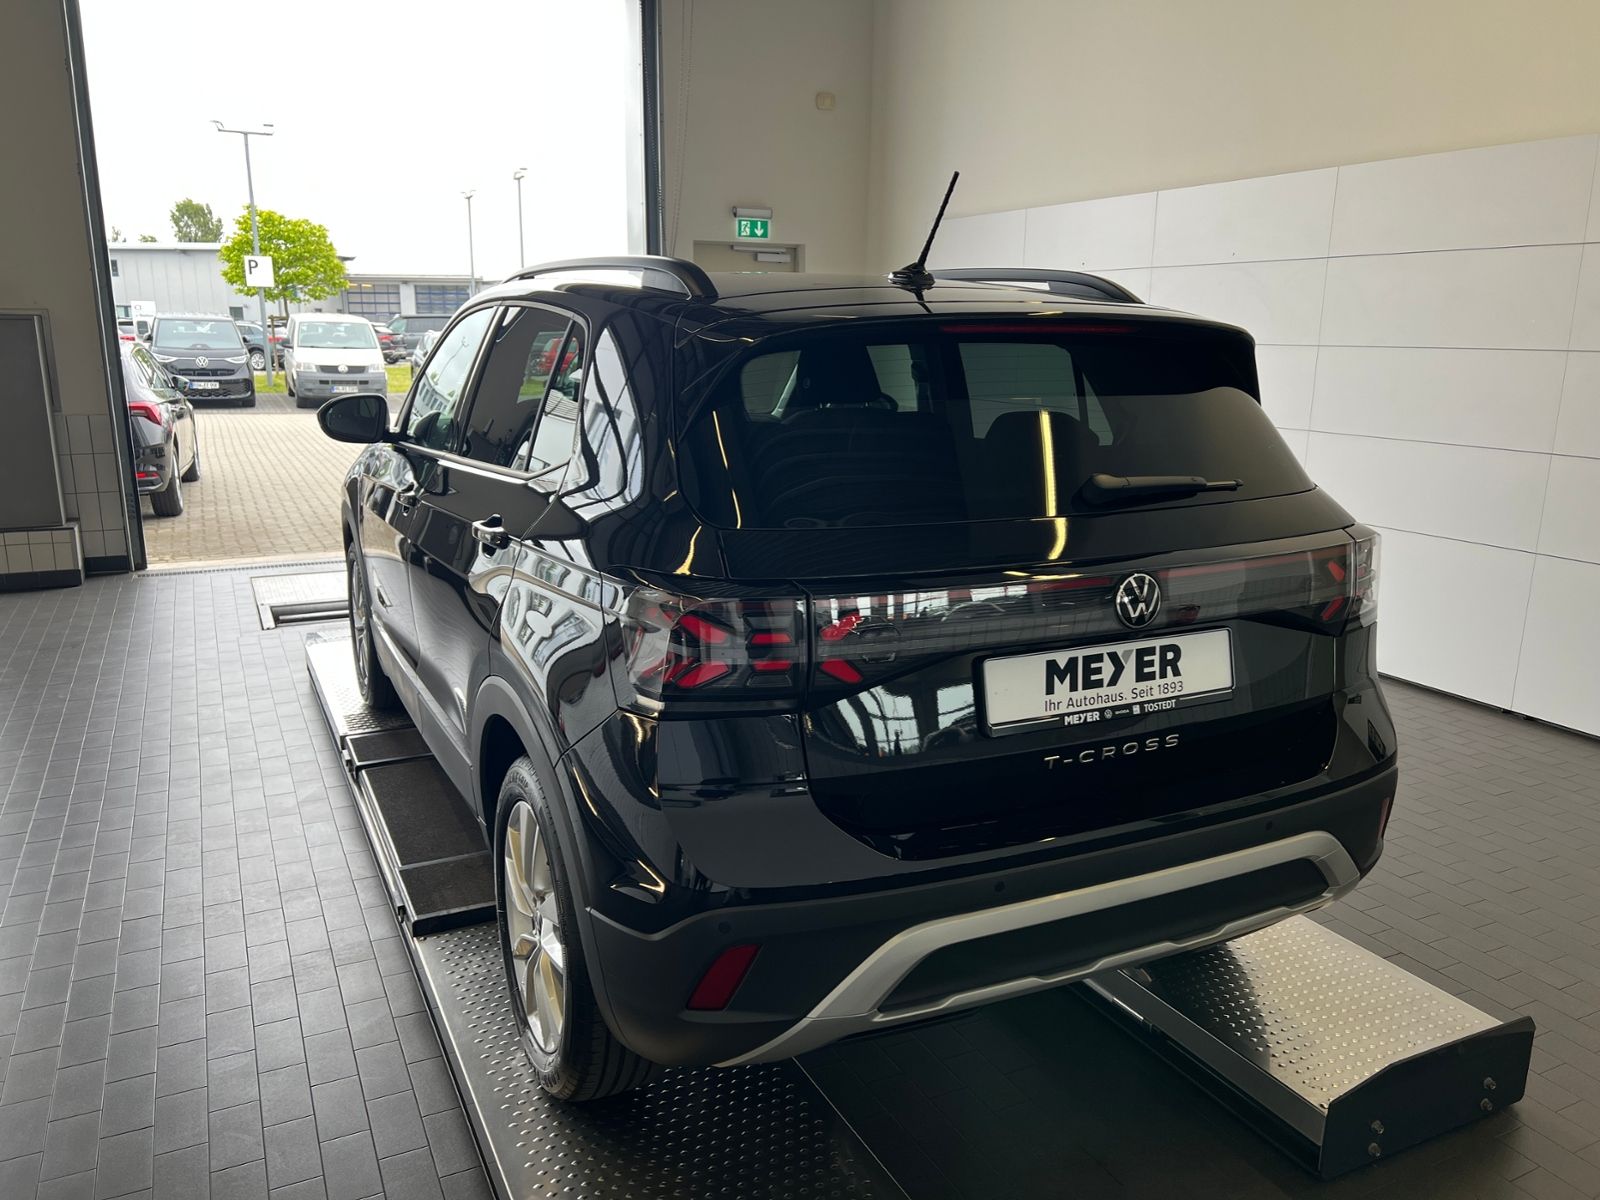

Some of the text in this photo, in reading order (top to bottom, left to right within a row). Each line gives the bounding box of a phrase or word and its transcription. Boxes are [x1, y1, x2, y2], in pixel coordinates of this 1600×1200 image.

[248, 259, 258, 275] P
[1045, 643, 1182, 695] MEYER
[1044, 681, 1183, 711] Ihr Autohaus. Seit 1893
[1064, 711, 1100, 725] MEYER
[1144, 700, 1176, 712] TOSTEDT
[1044, 734, 1179, 769] T-CROSS
